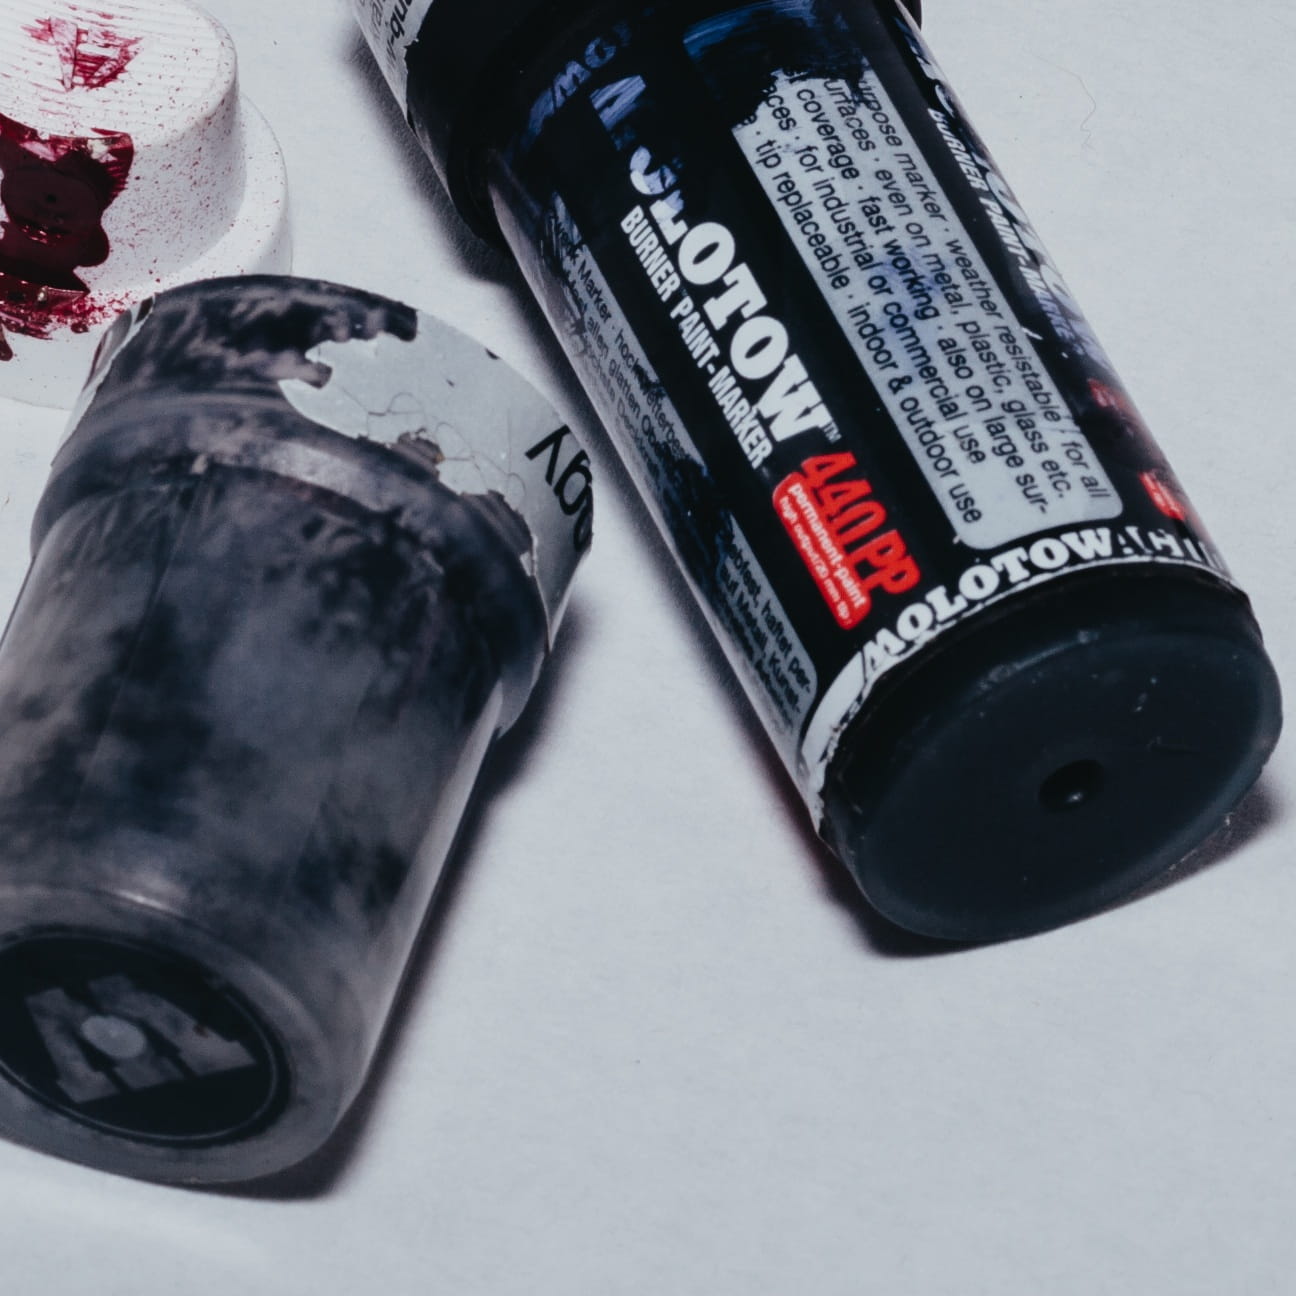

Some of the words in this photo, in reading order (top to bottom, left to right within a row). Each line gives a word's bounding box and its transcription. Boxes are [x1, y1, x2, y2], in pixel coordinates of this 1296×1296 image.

[621, 206, 680, 301] BURNER
[670, 296, 772, 468] PAINT-MARKER
[756, 140, 781, 168] tip
[773, 172, 850, 289] replaceable
[848, 303, 898, 370] indoor
[888, 376, 912, 394] &
[900, 397, 959, 477] outdoor
[949, 484, 982, 523] use
[795, 146, 829, 172] for
[813, 178, 885, 271] industrial
[868, 275, 893, 294] or
[883, 302, 967, 420] commercial
[953, 426, 986, 463] use
[797, 89, 859, 179] coverage
[858, 196, 895, 235] fast
[884, 239, 940, 320] working
[937, 338, 973, 379] also
[966, 385, 992, 412] on
[983, 416, 1024, 468] large
[1016, 474, 1048, 513] sur-
[875, 170, 913, 216] even
[906, 223, 931, 247] on
[922, 254, 972, 314] metal,
[955, 321, 1011, 393] plastic,
[1000, 400, 1048, 453] glass
[1041, 460, 1071, 497] etc.
[894, 154, 947, 221] marker
[946, 240, 1003, 318] weather
[994, 326, 1061, 421] resistable
[1061, 441, 1089, 469] for
[1080, 476, 1110, 498] all
[774, 493, 802, 526] high
[785, 479, 870, 611] permanent-paint
[863, 526, 1112, 667] MOLOTOW
